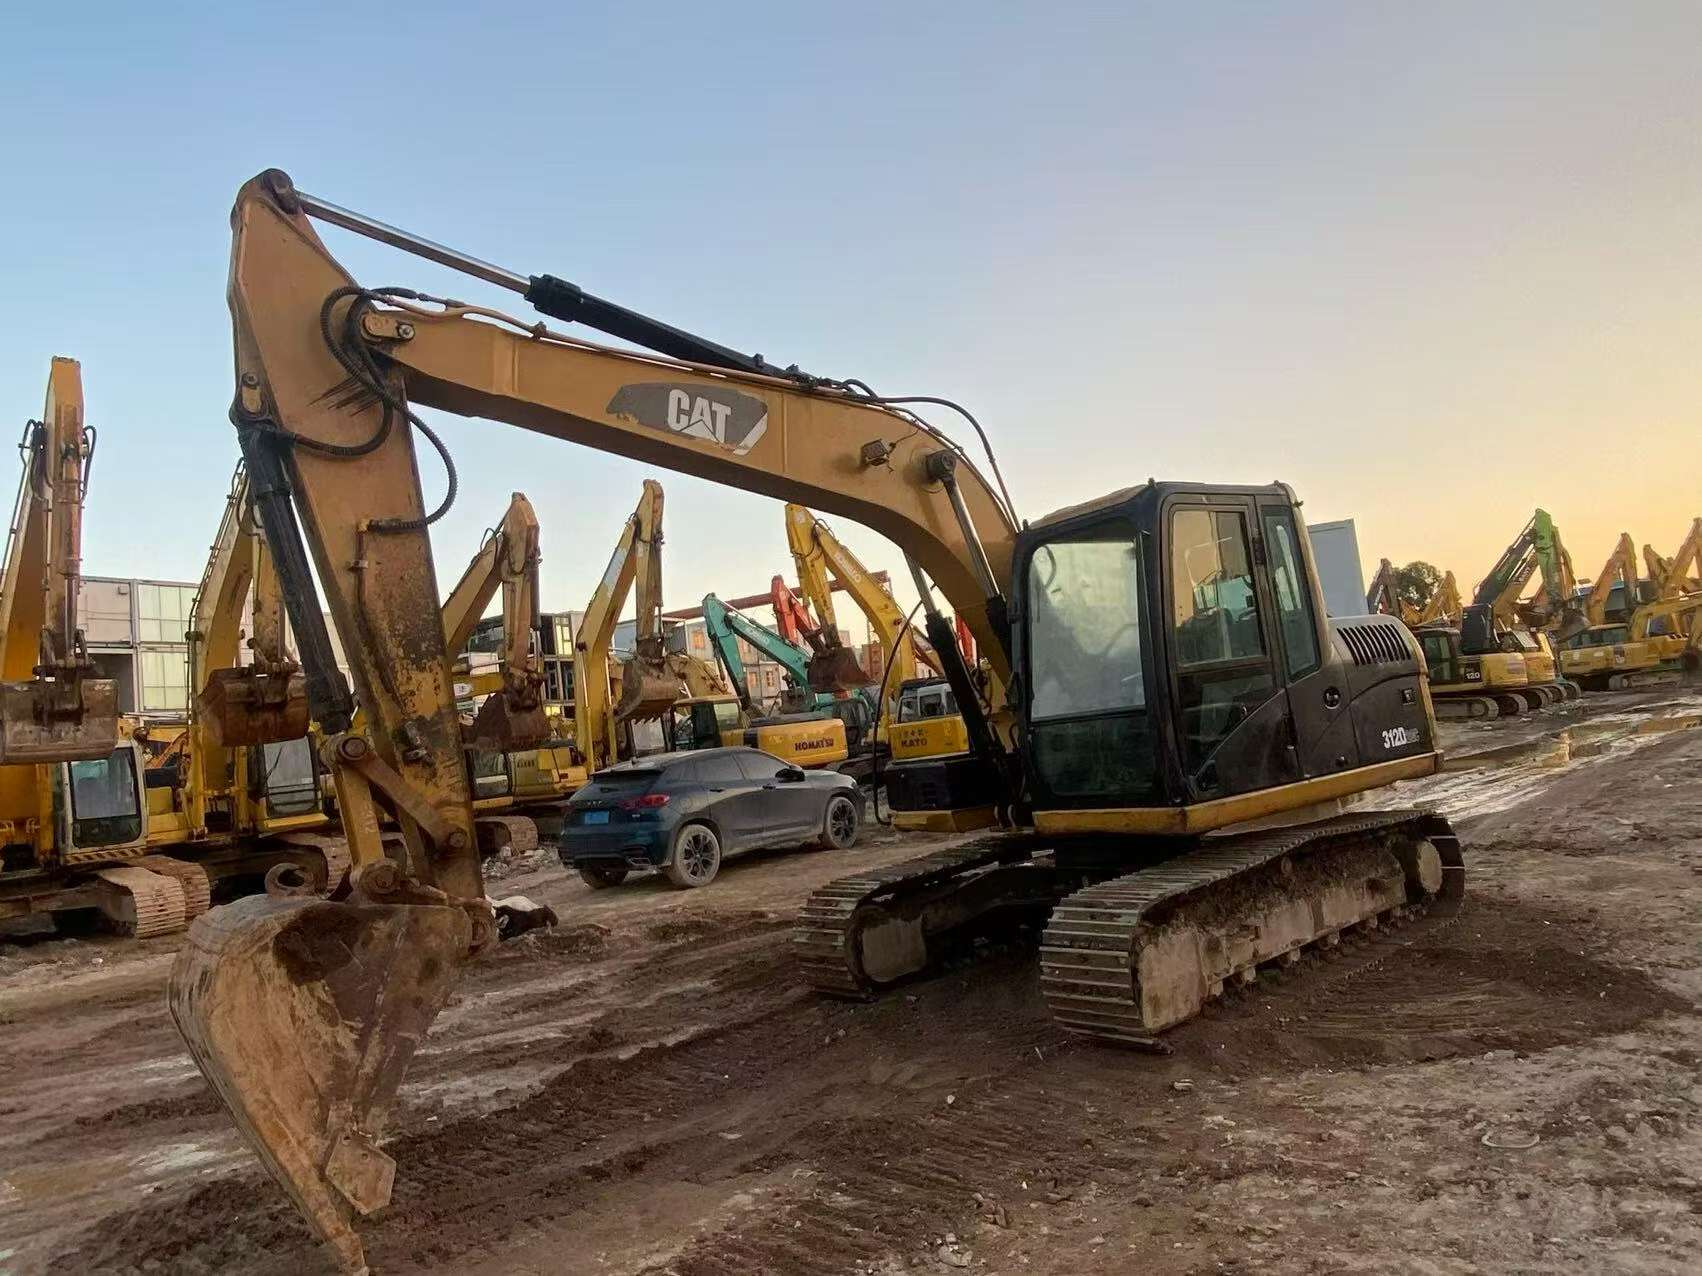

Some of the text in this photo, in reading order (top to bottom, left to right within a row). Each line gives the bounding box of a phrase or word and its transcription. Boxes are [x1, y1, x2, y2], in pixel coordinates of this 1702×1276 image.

[668, 389, 732, 443] CAT
[1465, 672, 1480, 680] 120
[795, 738, 834, 751] KOMATSU
[1382, 727, 1407, 749] 312D
